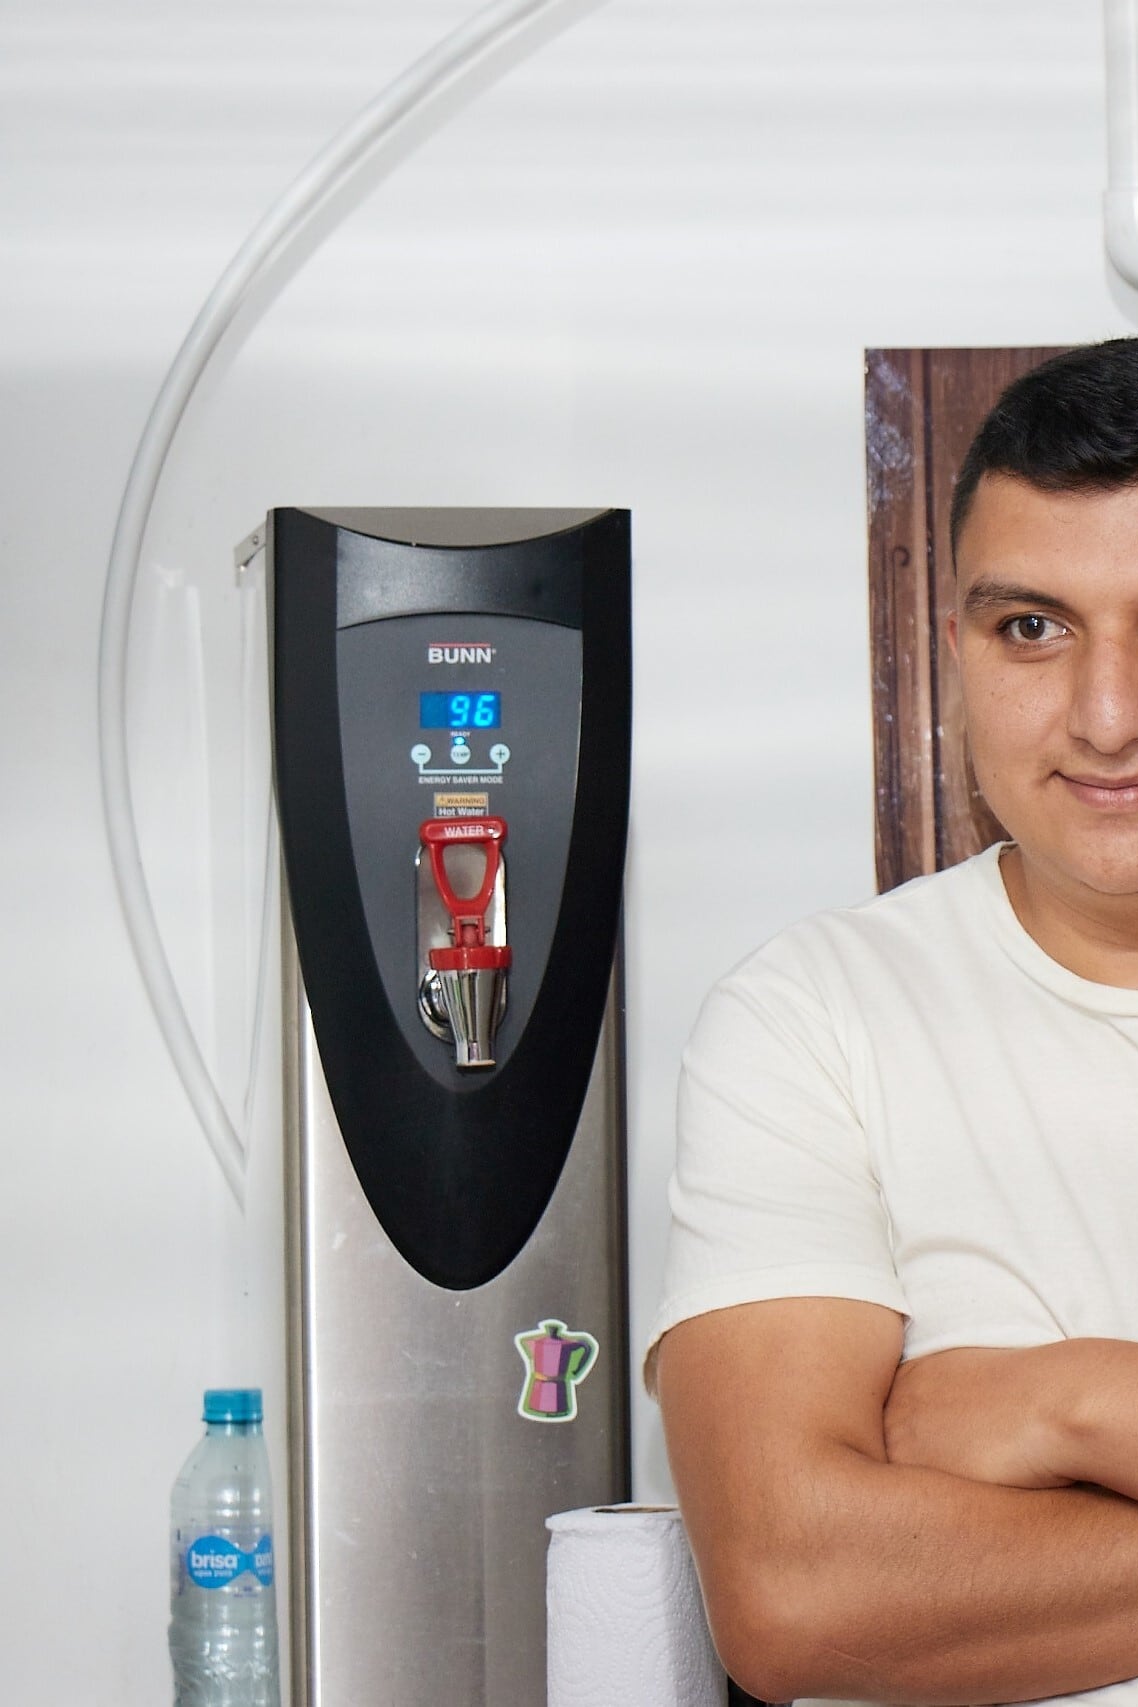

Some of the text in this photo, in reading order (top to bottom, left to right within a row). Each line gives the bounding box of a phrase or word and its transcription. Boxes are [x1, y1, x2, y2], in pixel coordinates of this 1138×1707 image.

[428, 648, 492, 664] BUNN
[450, 694, 496, 727] 96
[418, 776, 503, 784] ENERGY SAVER MODE
[447, 797, 485, 805] WARNING
[438, 808, 484, 816] Hot Water
[444, 826, 484, 837] WATER
[191, 1550, 238, 1569] brisa
